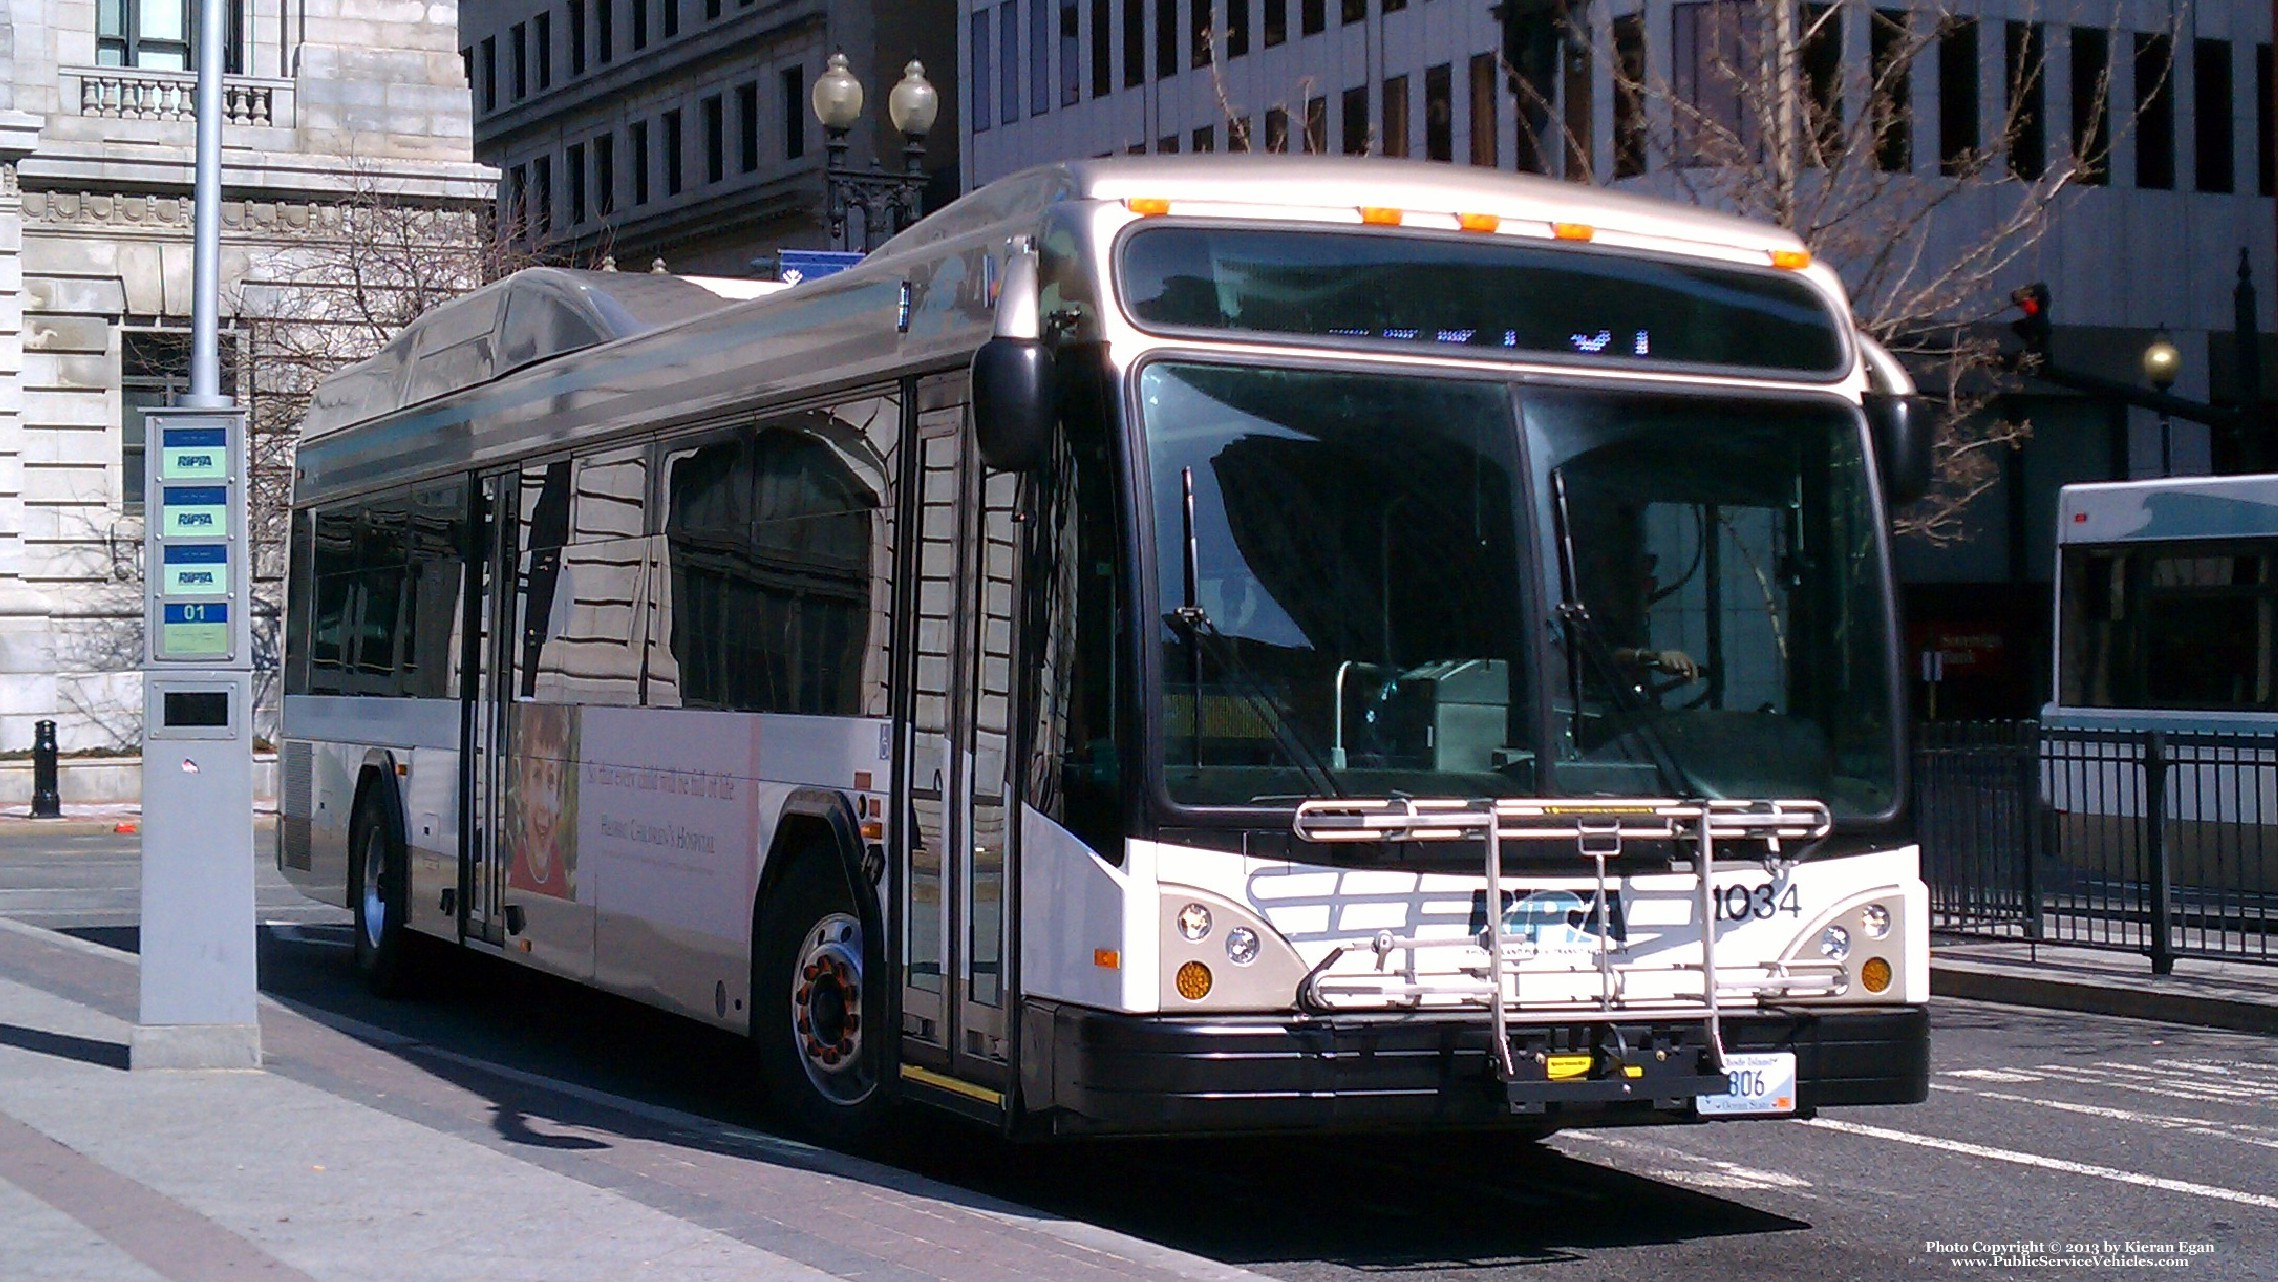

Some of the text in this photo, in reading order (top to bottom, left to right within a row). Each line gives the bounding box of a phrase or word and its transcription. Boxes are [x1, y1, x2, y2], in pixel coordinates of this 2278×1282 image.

[177, 455, 212, 467] RIPTA
[178, 513, 212, 526] RIPTA
[178, 571, 213, 584] RIPTA
[184, 605, 205, 620] 01
[1712, 883, 1802, 921] 1034
[1729, 1070, 1764, 1097] 806
